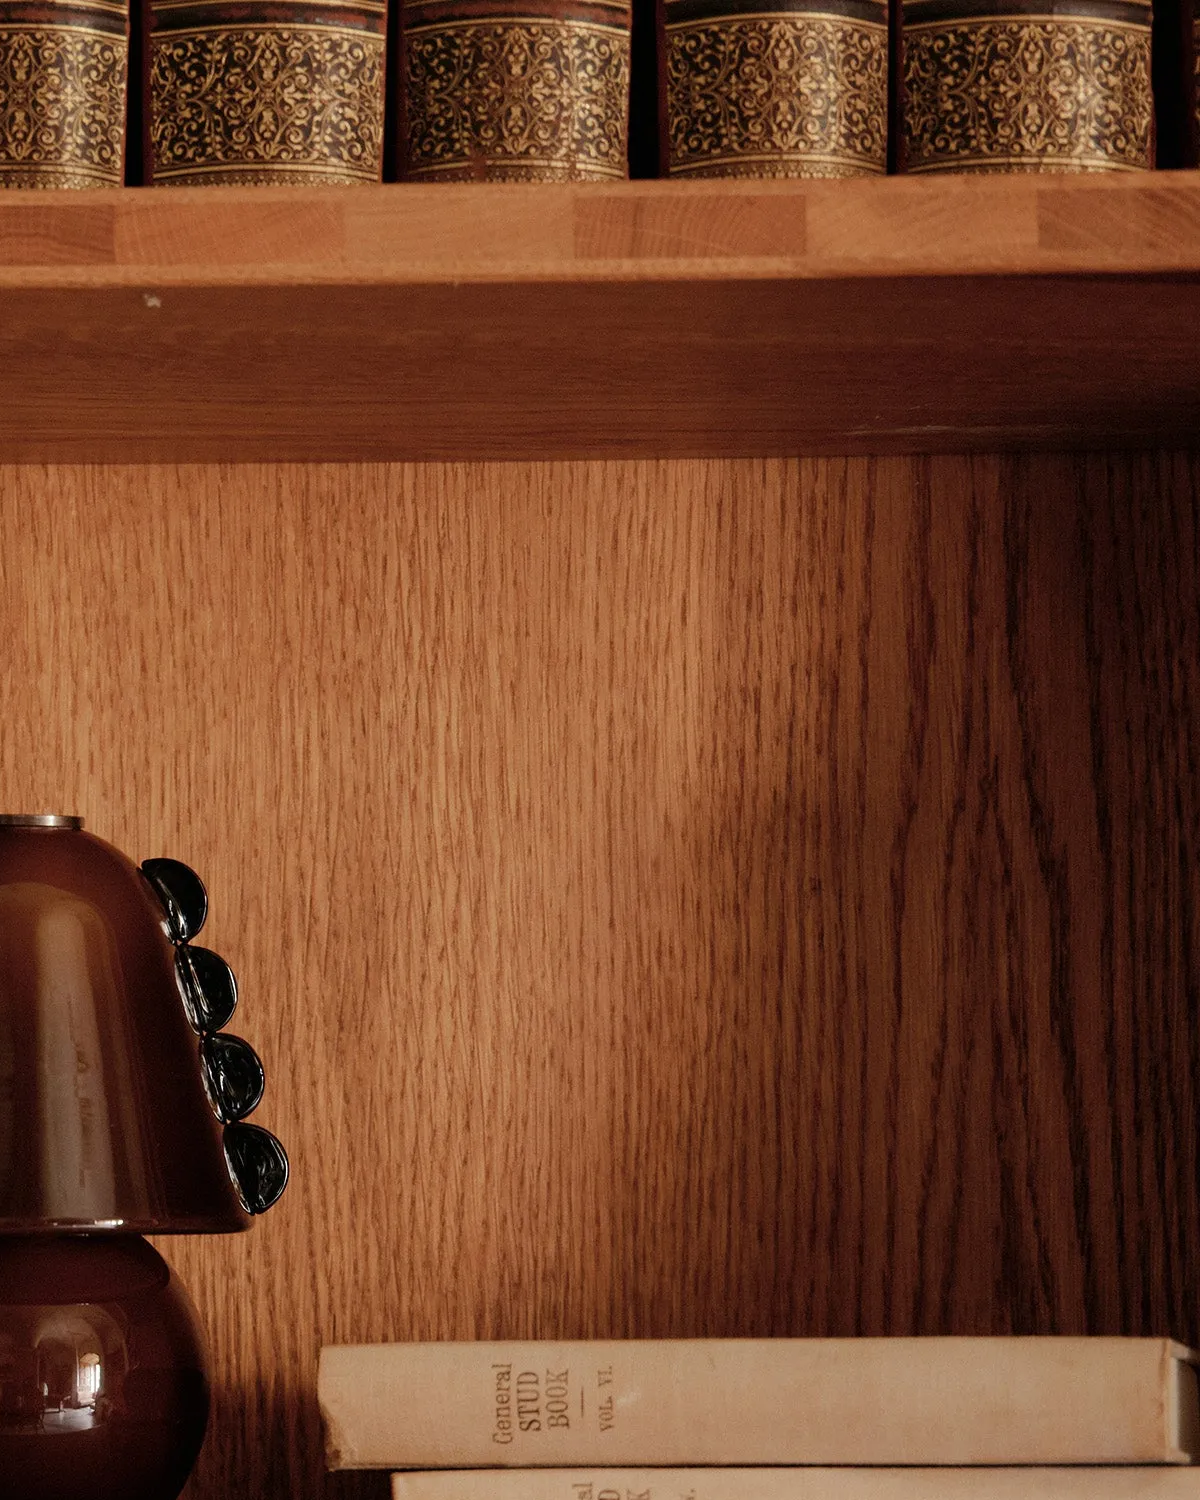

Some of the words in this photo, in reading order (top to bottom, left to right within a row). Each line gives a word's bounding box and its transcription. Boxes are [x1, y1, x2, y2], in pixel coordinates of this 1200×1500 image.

[492, 1362, 513, 1445] General
[517, 1371, 541, 1433] STUD
[546, 1367, 570, 1430] BOOK
